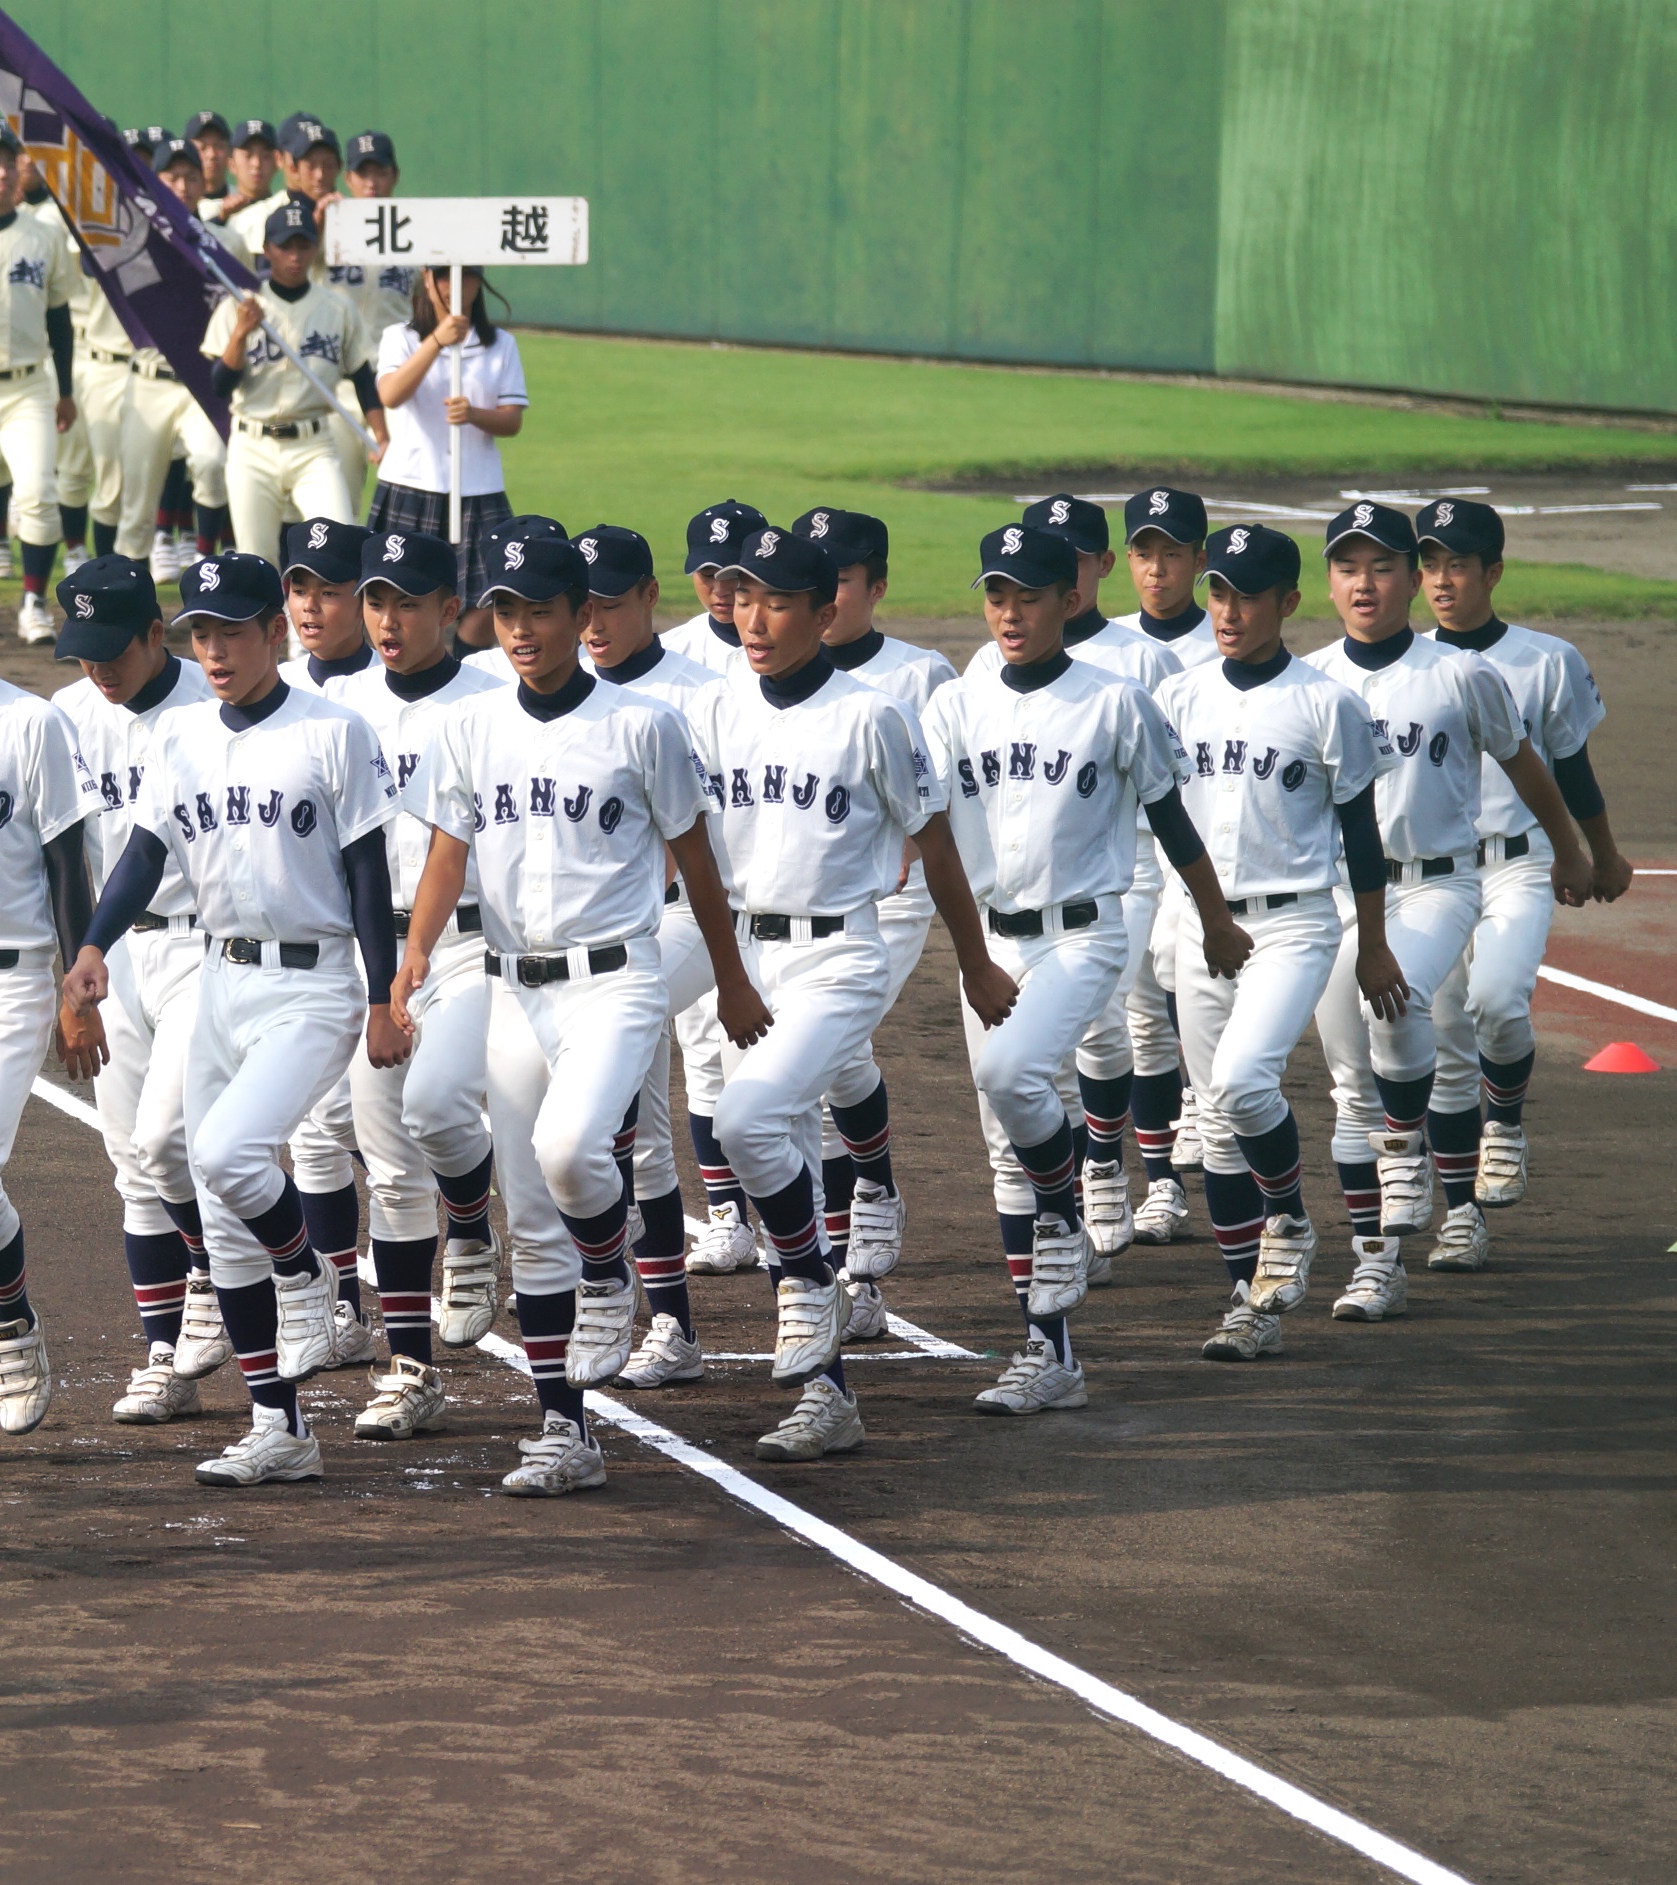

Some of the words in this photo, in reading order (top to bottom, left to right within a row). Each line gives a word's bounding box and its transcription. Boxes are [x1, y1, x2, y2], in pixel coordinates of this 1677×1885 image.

[358, 135, 374, 152] H
[286, 209, 302, 226] H
[364, 205, 549, 255] 北越
[1048, 500, 1072, 525] S
[1149, 491, 1170, 516] S
[1352, 504, 1375, 528] S
[1434, 502, 1455, 528] S
[307, 522, 329, 550] S
[709, 518, 730, 543] S
[810, 512, 830, 538] S
[382, 534, 406, 562] S
[578, 537, 598, 565] S
[755, 531, 780, 558] S
[1000, 527, 1024, 555] S
[1226, 529, 1250, 555] S
[504, 541, 525, 571] S
[199, 562, 220, 592] S
[74, 593, 95, 620] S
[958, 742, 1099, 799] SANJO
[1183, 739, 1308, 793] ANJO
[174, 785, 318, 844] SANJO
